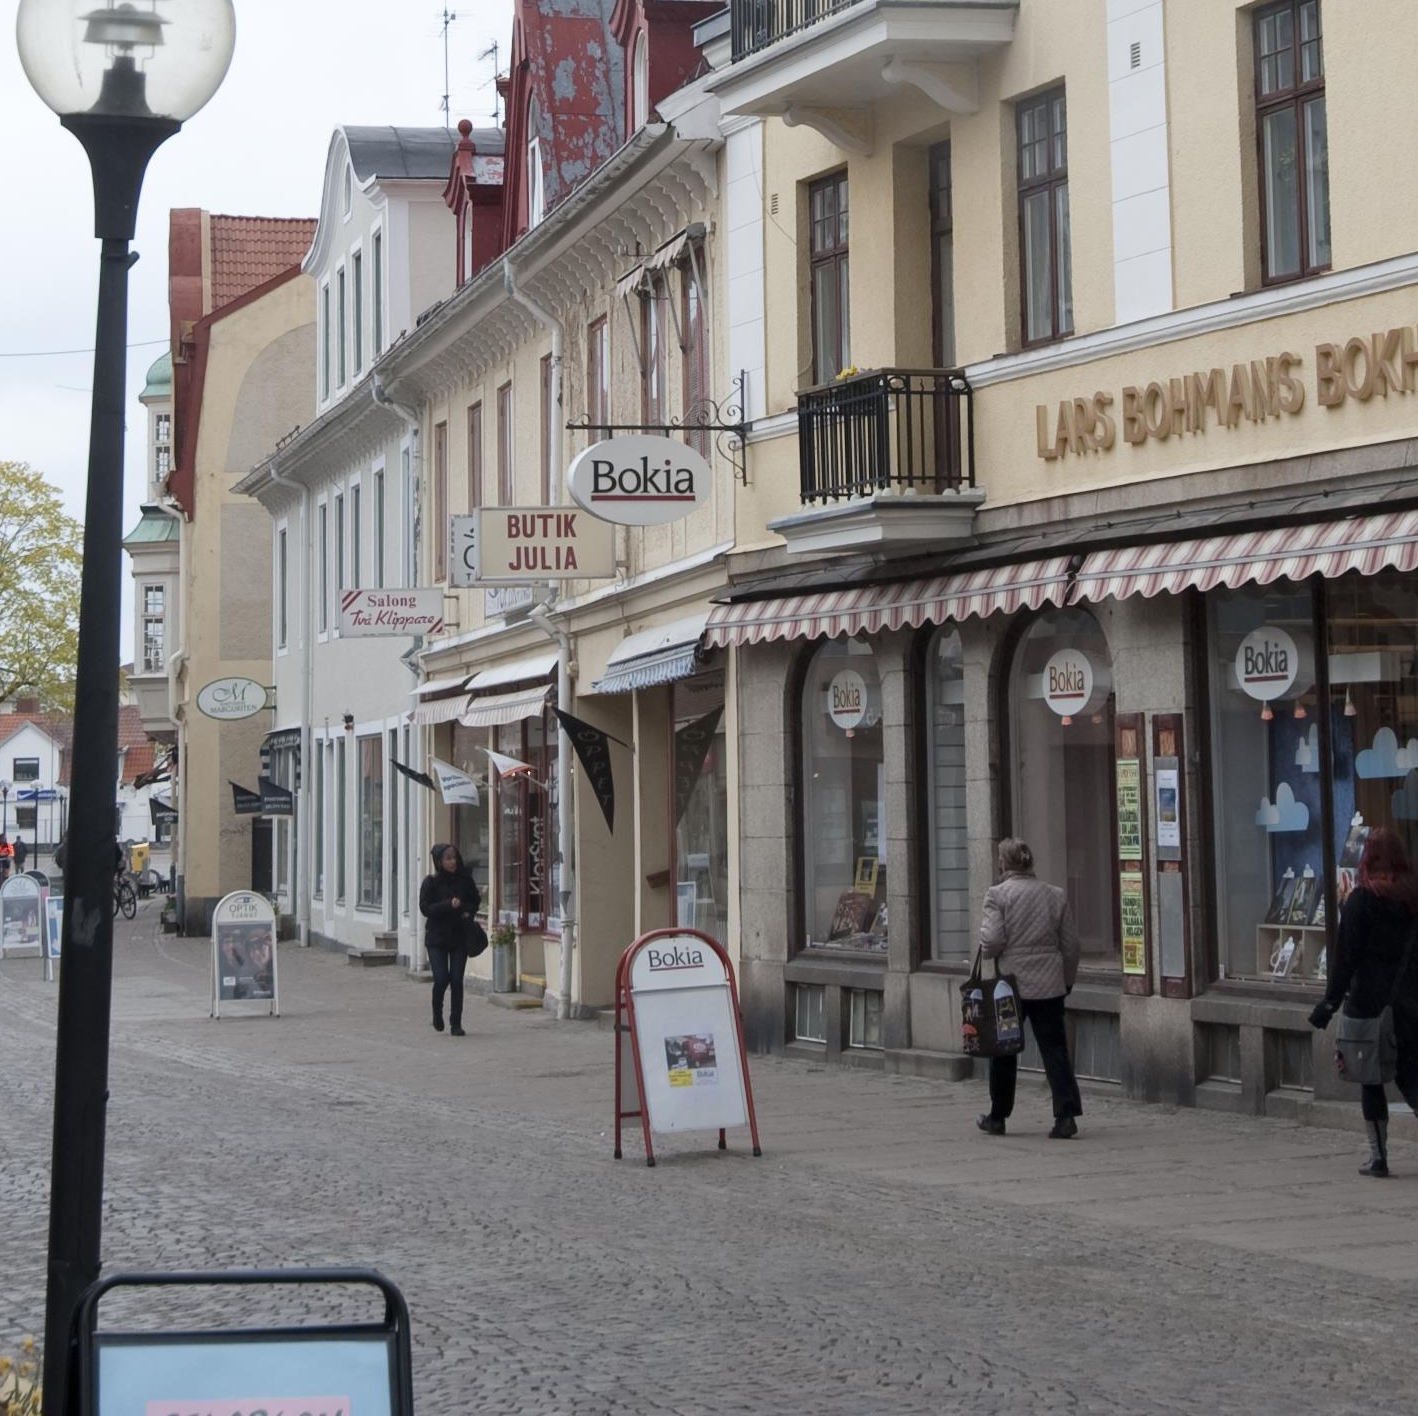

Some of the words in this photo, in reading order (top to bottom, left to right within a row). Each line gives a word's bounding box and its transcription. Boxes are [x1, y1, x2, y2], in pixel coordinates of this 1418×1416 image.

[1035, 390, 1116, 460] LARS
[1122, 350, 1306, 445] BOHMANS
[590, 455, 696, 495] Bokia
[506, 513, 578, 539] BUTIK
[508, 545, 579, 571] JULIA
[366, 593, 417, 610] Salong
[350, 609, 373, 627] Två
[374, 609, 435, 631] Klippare
[1244, 640, 1289, 675] Bokia
[1049, 661, 1085, 692] Bokia
[833, 680, 861, 709] Bokia
[229, 904, 258, 913] OPTIK
[647, 945, 704, 968] Bokia
